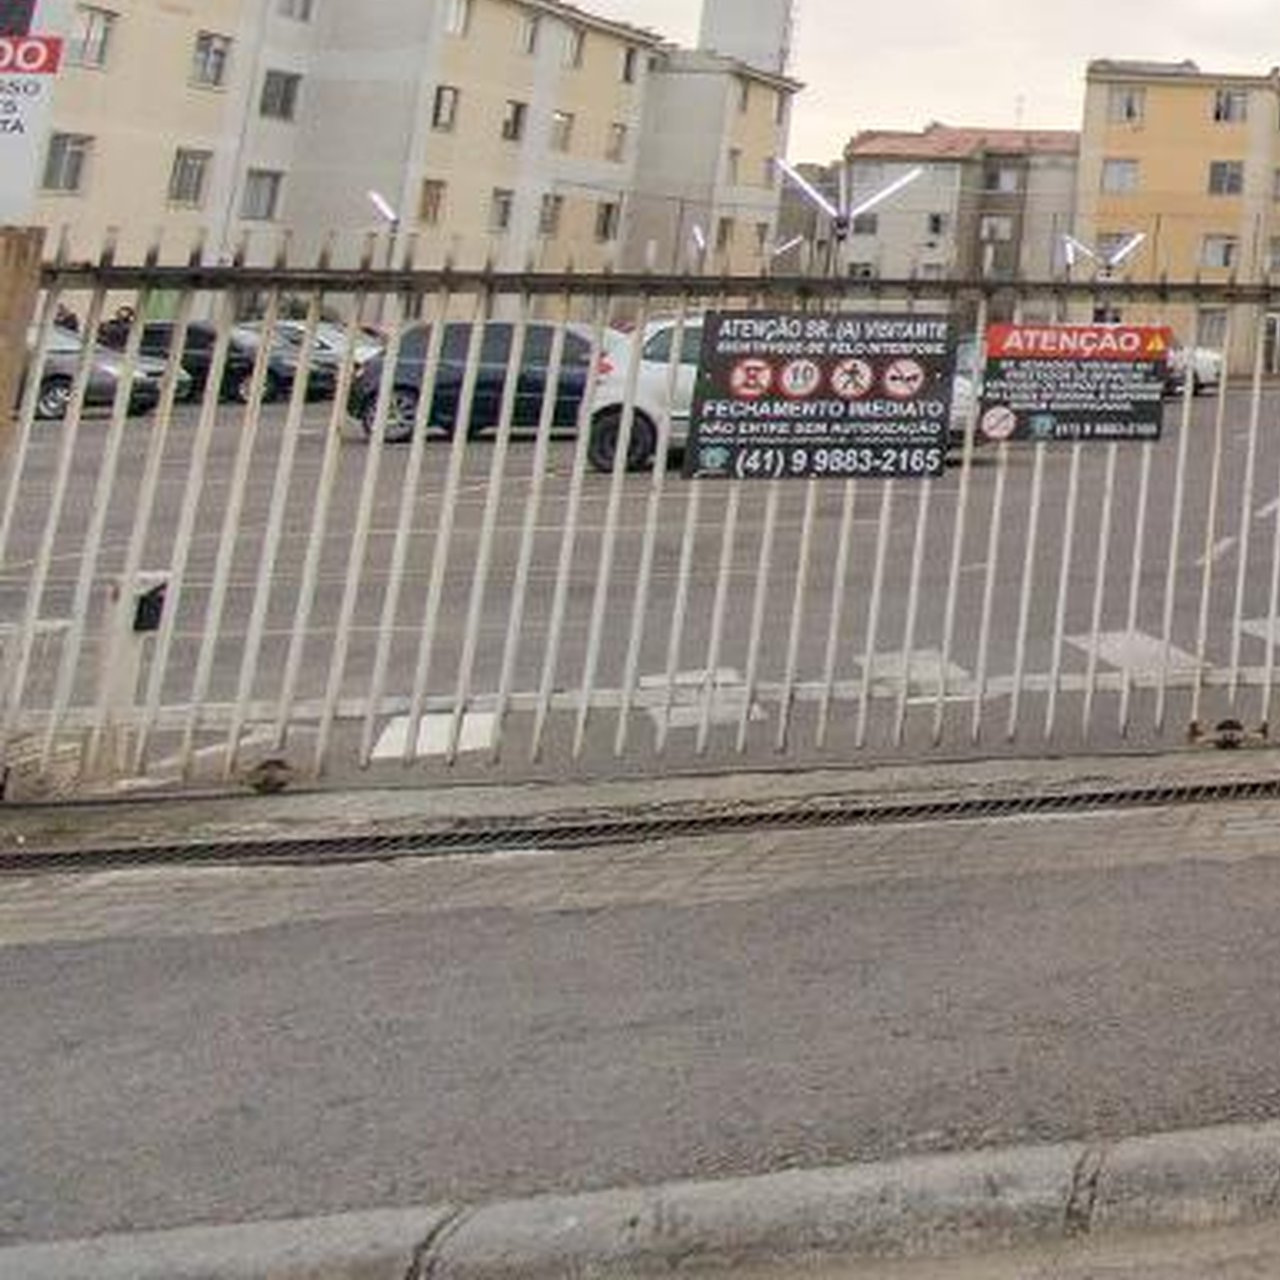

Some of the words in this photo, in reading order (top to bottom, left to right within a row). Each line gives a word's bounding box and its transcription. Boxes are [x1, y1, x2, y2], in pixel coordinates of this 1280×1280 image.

[718, 317, 801, 340] ATENÇÃO
[805, 320, 835, 339] SR.
[836, 321, 861, 341] (A)
[864, 322, 948, 340] VISITANTE
[702, 400, 845, 417] FECHAMENTO
[849, 400, 944, 417] IMEDIATO
[700, 421, 735, 434] NÃO
[794, 422, 827, 435] SEM
[735, 449, 784, 478] (41)
[791, 449, 807, 471] 9
